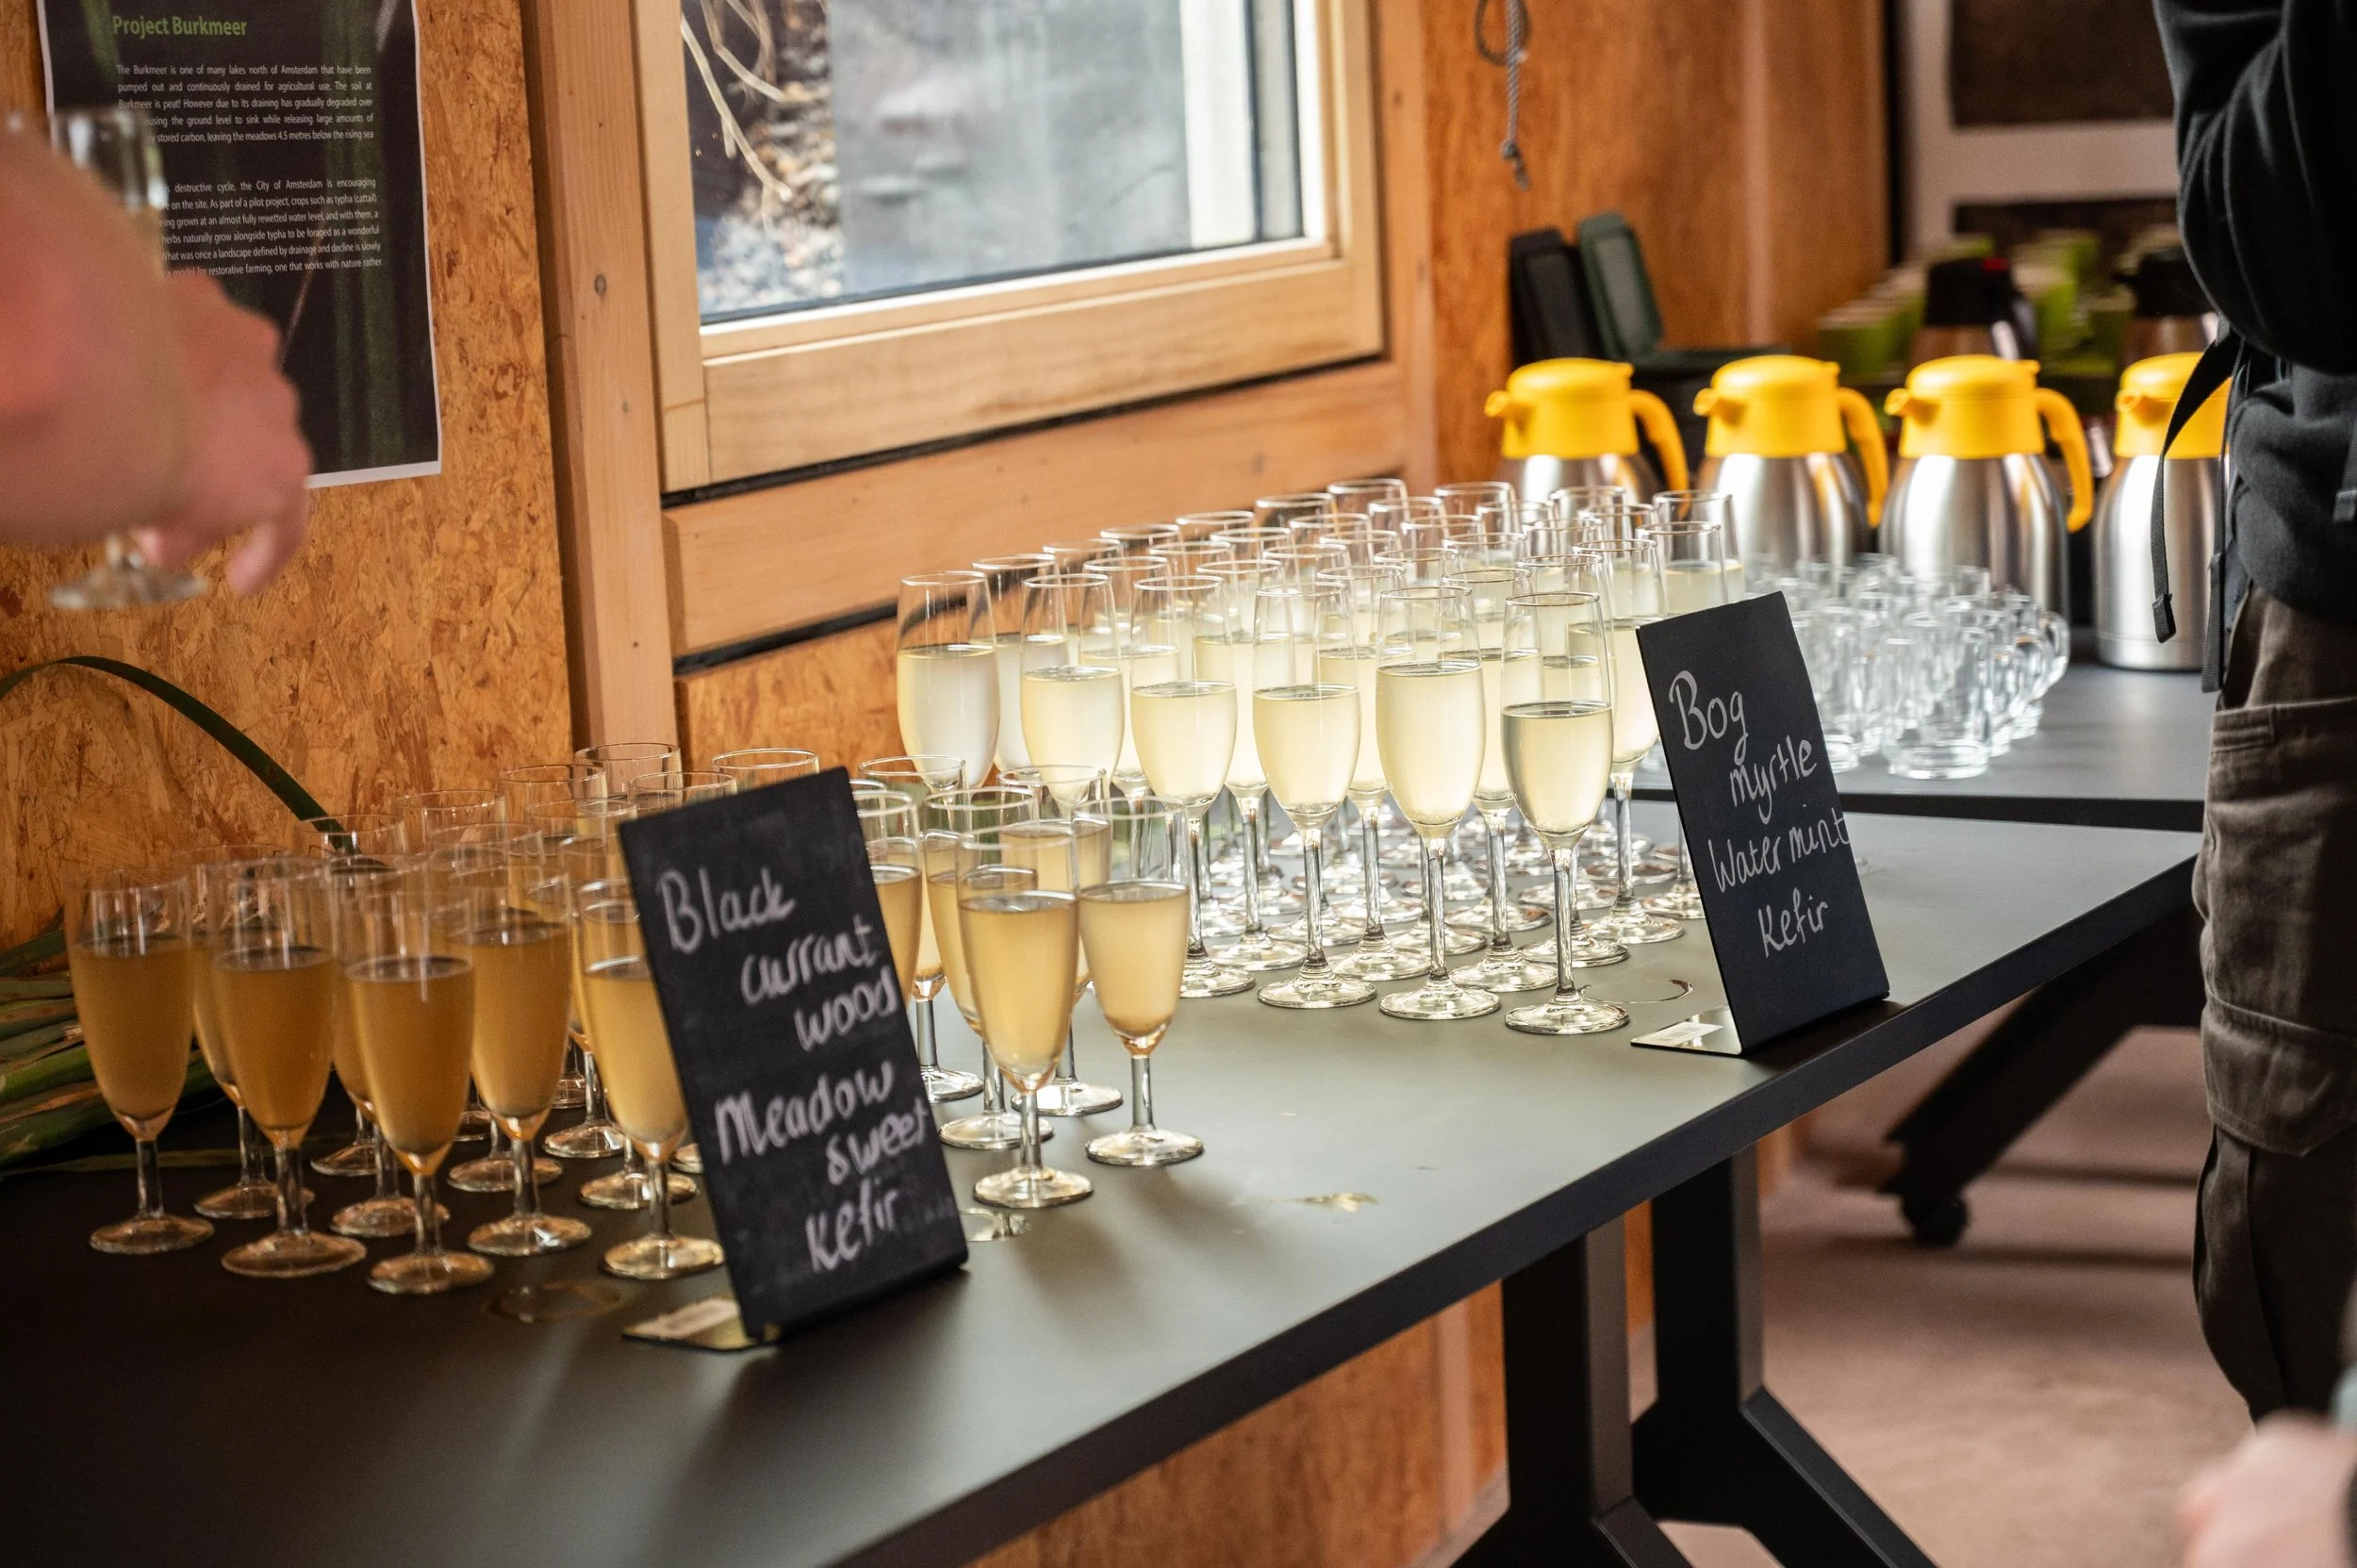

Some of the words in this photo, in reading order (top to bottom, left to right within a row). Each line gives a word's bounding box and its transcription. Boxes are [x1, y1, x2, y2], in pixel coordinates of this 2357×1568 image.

[112, 15, 170, 40] Project
[172, 15, 248, 36] Burkmeer
[117, 65, 130, 74] The
[133, 65, 168, 74] Burkmeer
[170, 66, 177, 74] is
[196, 64, 205, 74] of
[206, 67, 226, 76] many
[228, 64, 246, 74] lakes
[248, 65, 268, 74] north
[271, 65, 278, 74] of
[281, 65, 319, 74] Amsterdam
[321, 65, 335, 74] that
[337, 65, 353, 74] have
[354, 65, 372, 74] been
[117, 82, 148, 93] pumped
[151, 83, 165, 91] out
[169, 82, 183, 91] and
[187, 82, 231, 93] continuously
[234, 82, 261, 91] drained
[264, 81, 274, 91] for
[277, 81, 315, 92] agricultural
[335, 81, 348, 91] The
[351, 81, 362, 91] soil
[365, 82, 373, 91] at
[118, 99, 152, 108] Burkmeer
[155, 99, 161, 108] is
[162, 99, 181, 110] peat!
[183, 99, 214, 107] However
[216, 98, 229, 107] due
[240, 98, 250, 107] its
[251, 98, 279, 109] draining
[280, 98, 293, 107] has
[294, 97, 324, 109] gradually
[326, 97, 357, 108] degraded
[171, 115, 184, 125] the
[187, 115, 212, 127] ground
[215, 114, 232, 124] level
[235, 116, 243, 124] to
[245, 115, 260, 124] sink
[262, 114, 281, 124] while
[284, 114, 313, 125] releasing
[316, 114, 333, 125] large
[335, 114, 364, 123] amounts
[366, 113, 374, 123] of
[157, 132, 180, 142] stored
[180, 133, 206, 142] carbon,
[206, 132, 232, 143] leaving
[232, 132, 244, 141] the
[244, 131, 277, 140] meadows
[277, 131, 288, 140] 4.5
[288, 132, 311, 140] metres
[312, 130, 331, 140] below
[333, 130, 344, 140] the
[344, 130, 362, 141] rising
[363, 131, 374, 140] sea
[174, 182, 213, 193] destructive
[239, 181, 253, 190] the
[255, 180, 270, 192] City
[273, 179, 281, 190] of
[286, 179, 323, 189] Amsterdam
[326, 179, 333, 188] is
[337, 177, 376, 189] encouraging
[181, 200, 193, 209] the
[195, 199, 208, 209] site.
[209, 198, 218, 207] As
[219, 199, 234, 209] part
[235, 197, 242, 206] of
[248, 196, 264, 209] pilot
[290, 196, 309, 206] crops
[310, 194, 325, 205] such
[334, 194, 353, 206] typha
[158, 217, 175, 229] eing
[176, 219, 199, 228] grown
[200, 217, 207, 225] at
[218, 214, 241, 225] almost
[242, 213, 256, 225] fully
[257, 211, 288, 223] rewetted
[288, 212, 306, 222] water
[325, 210, 338, 220] and
[338, 208, 354, 219] with
[161, 234, 182, 243] herbs
[183, 231, 213, 244] naturally
[214, 234, 232, 243] grow
[233, 229, 265, 242] alongside
[267, 227, 287, 241] typha
[287, 227, 295, 237] to
[296, 226, 305, 238] be
[306, 225, 332, 239] foraged
[347, 224, 380, 236] wonderful
[160, 251, 179, 261] What
[180, 252, 194, 260] was
[194, 251, 212, 259] once
[218, 247, 252, 259] landscape
[253, 244, 278, 256] defined
[278, 244, 288, 256] by
[288, 243, 317, 256] drainage
[318, 242, 330, 253] and
[331, 241, 354, 253] decline
[354, 241, 361, 251] is
[361, 240, 381, 253] slowly
[197, 264, 207, 275] for
[208, 264, 244, 275] restorative
[245, 262, 273, 274] farming,
[274, 262, 288, 272] one
[288, 260, 303, 271] that
[304, 260, 323, 270] works
[324, 259, 340, 269] with
[340, 259, 362, 268] nature
[363, 257, 382, 267] rather
[1668, 669, 1749, 766] Bog
[1729, 734, 1817, 825] myrtle
[1707, 831, 1781, 894] Water
[1788, 803, 1851, 863] mint
[656, 867, 796, 954] Black
[794, 966, 898, 1050] wood
[715, 1061, 894, 1165] Meadow
